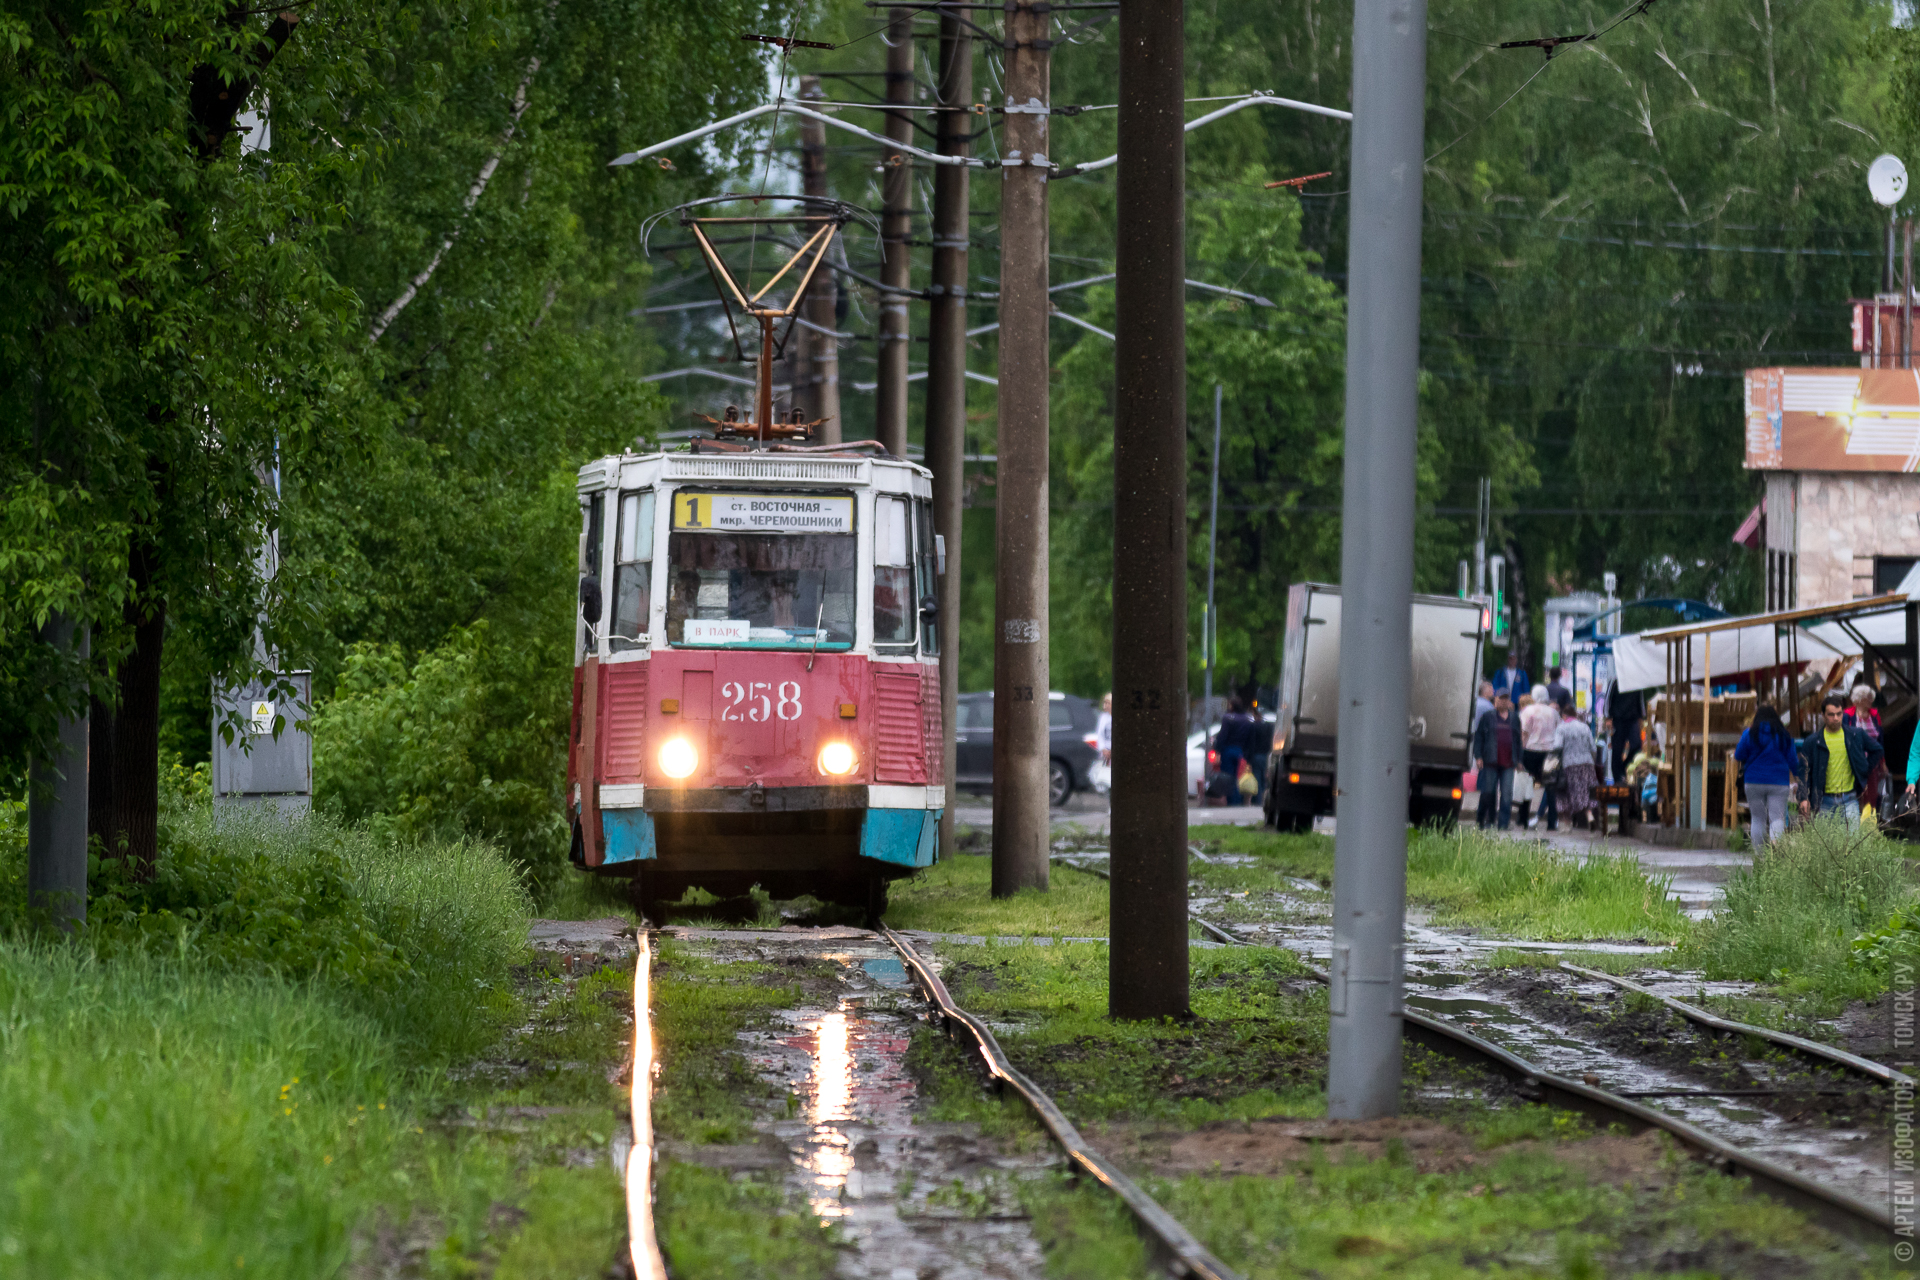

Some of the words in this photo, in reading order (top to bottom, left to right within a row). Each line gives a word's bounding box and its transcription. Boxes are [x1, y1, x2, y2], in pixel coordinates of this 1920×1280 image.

[686, 497, 702, 527] 1
[731, 503, 746, 511] ст.
[750, 501, 820, 513] ВОСТОЧНАЯ
[720, 517, 746, 526] мкр.
[750, 515, 843, 527] ЧЕРЕМОШНИКИ
[695, 627, 702, 636] В
[709, 627, 740, 637] ПАРК
[721, 681, 803, 722] 258
